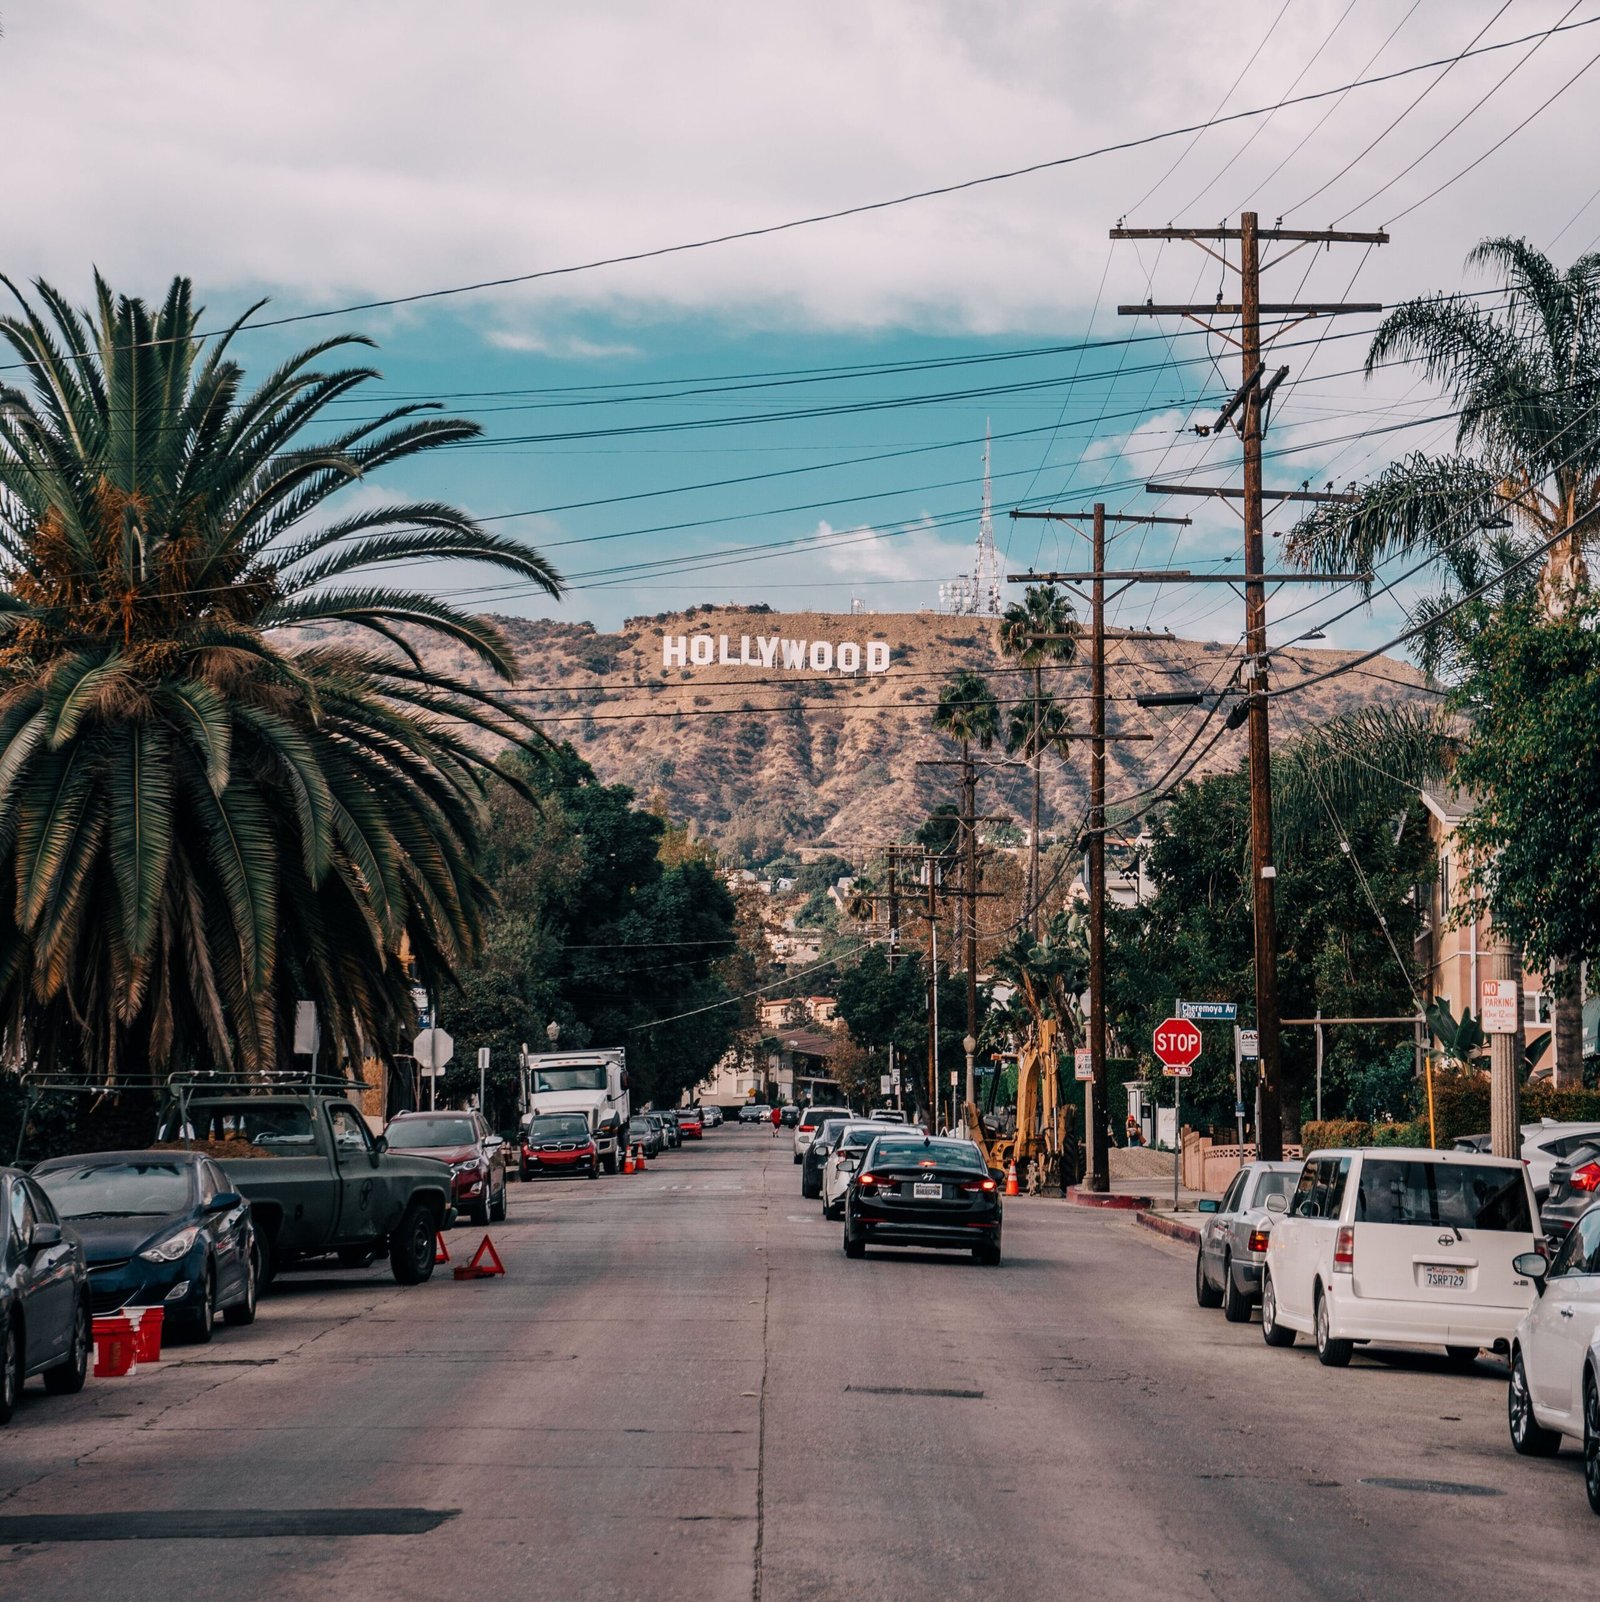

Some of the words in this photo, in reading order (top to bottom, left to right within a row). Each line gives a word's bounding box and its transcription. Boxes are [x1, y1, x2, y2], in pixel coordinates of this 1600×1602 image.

[663, 635, 890, 672] HOLLYWOOD
[1485, 983, 1496, 995] NO
[1485, 997, 1514, 1007] PARKING
[1182, 1003, 1222, 1014] Cheremoya
[1225, 1004, 1235, 1013] Av
[1157, 1033, 1198, 1052] STOP
[1427, 1274, 1464, 1286] 7SRP729
